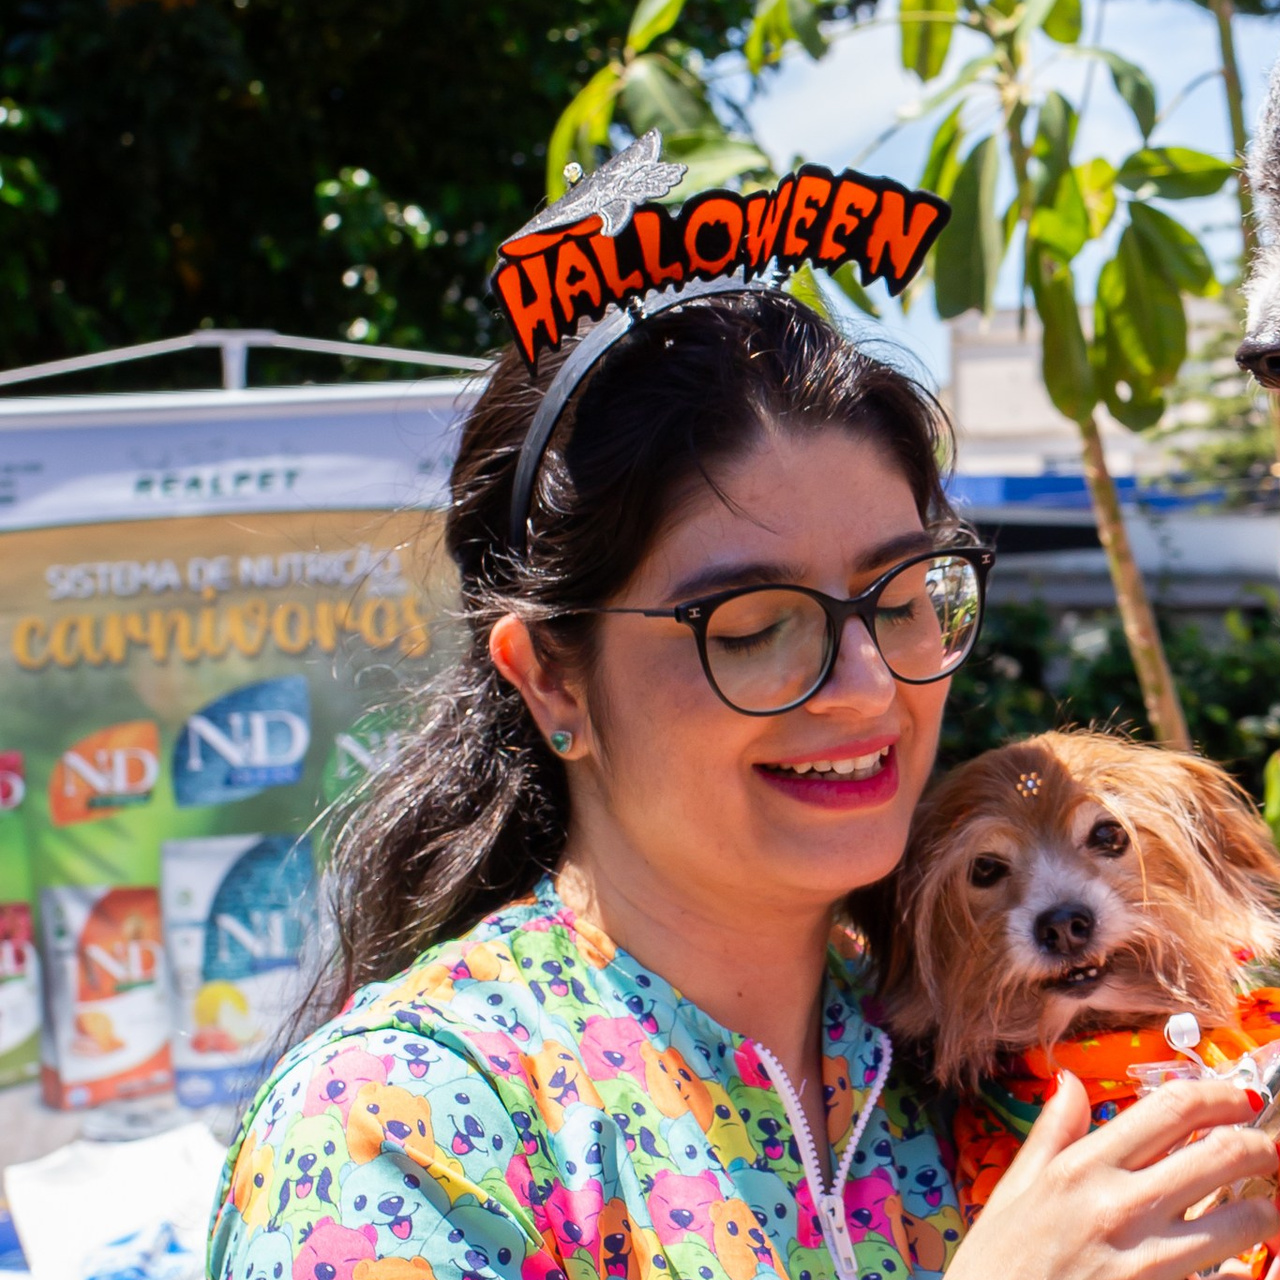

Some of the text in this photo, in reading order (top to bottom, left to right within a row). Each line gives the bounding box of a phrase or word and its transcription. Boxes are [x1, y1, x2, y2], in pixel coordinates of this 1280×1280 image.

[492, 164, 951, 374] HALLOWEEN
[134, 469, 300, 497] REALPET
[45, 557, 182, 600] SISTEMA
[187, 554, 232, 593] DE
